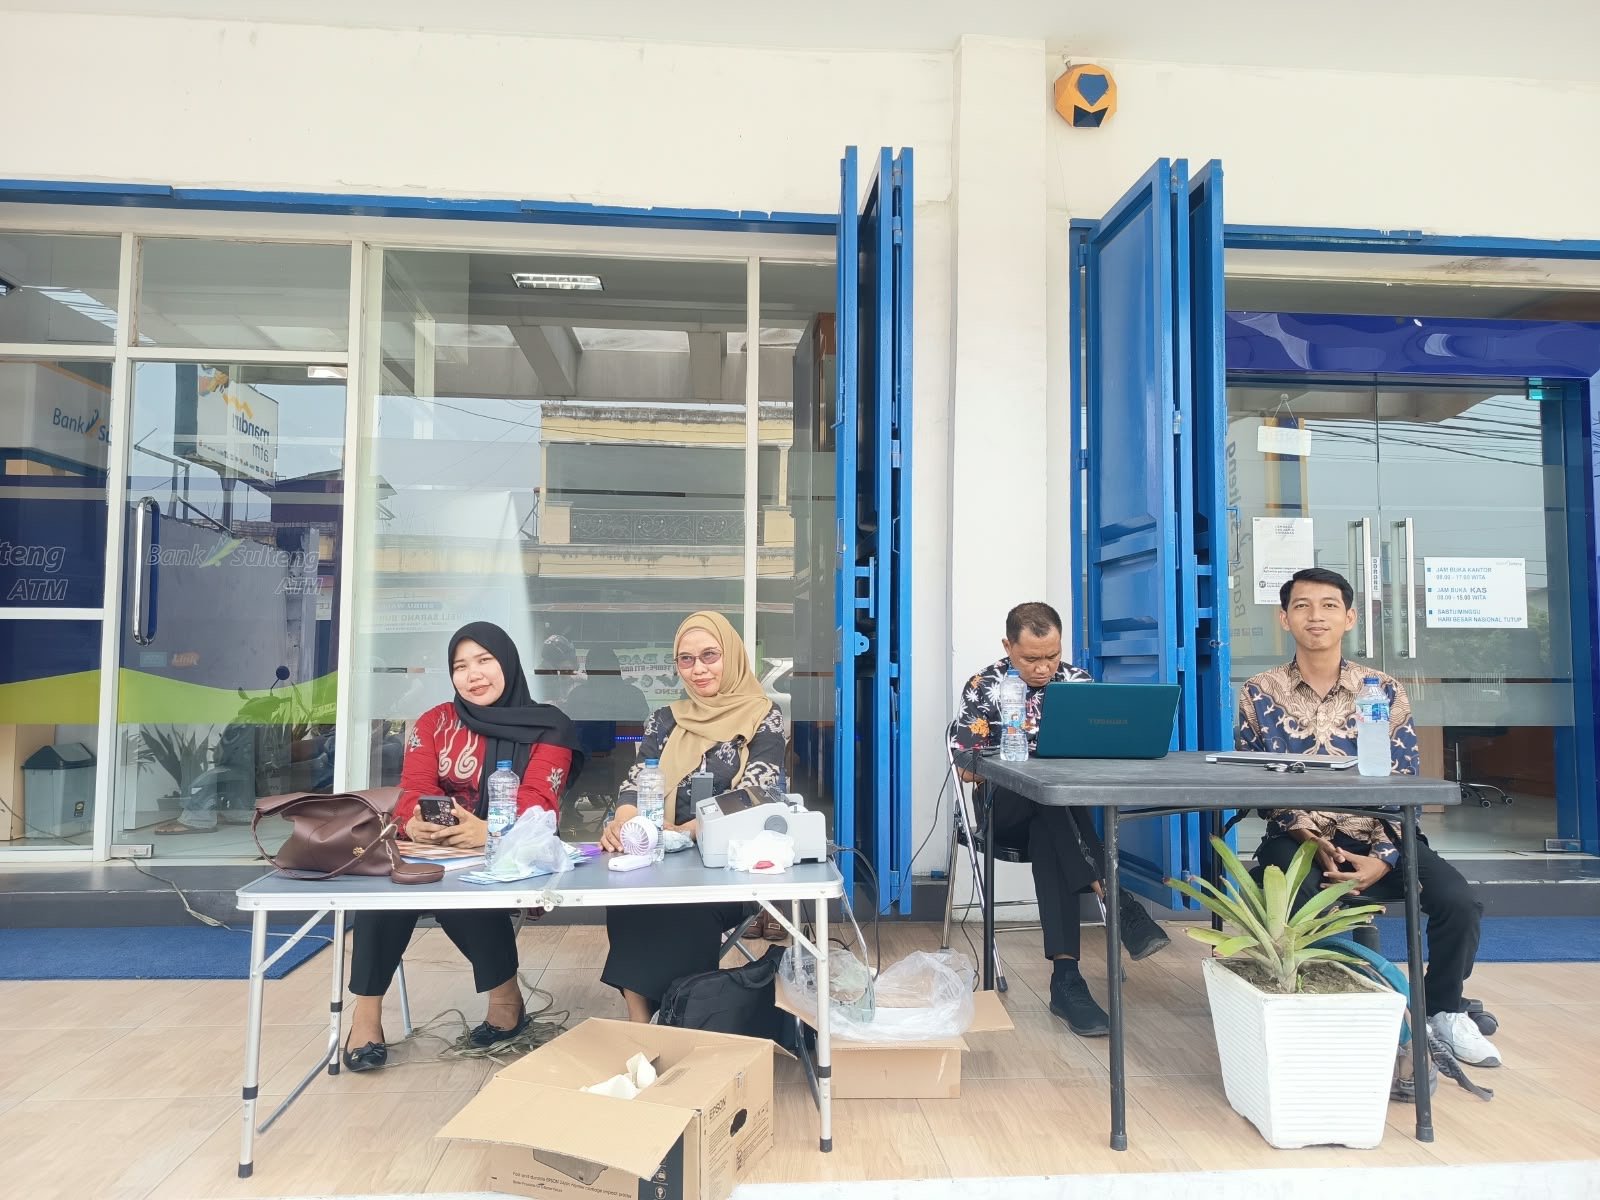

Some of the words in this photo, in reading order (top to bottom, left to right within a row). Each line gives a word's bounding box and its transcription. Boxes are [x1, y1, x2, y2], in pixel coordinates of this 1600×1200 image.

[53, 407, 85, 434] Bank
[145, 543, 207, 567] Bank
[229, 544, 320, 572] Sulteng
[6, 578, 69, 601] ATM
[274, 576, 324, 596] ATM
[709, 1095, 727, 1120] EPSON
